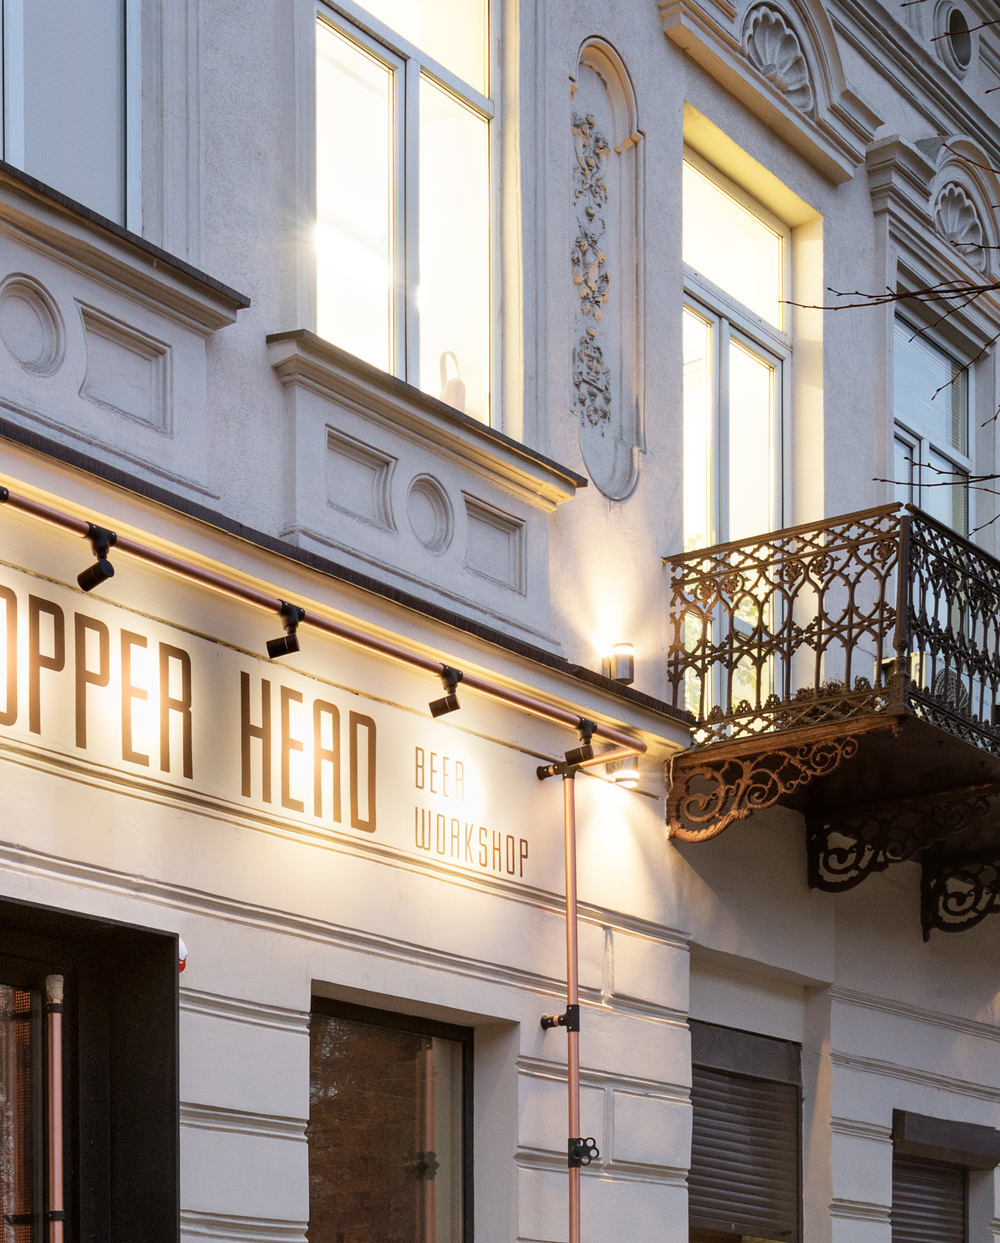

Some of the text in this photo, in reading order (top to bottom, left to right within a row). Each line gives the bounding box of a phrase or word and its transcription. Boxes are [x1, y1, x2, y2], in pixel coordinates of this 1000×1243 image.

[240, 671, 377, 834] HEAD
[415, 746, 465, 802] BEER
[415, 806, 528, 878] WORKSHOP
